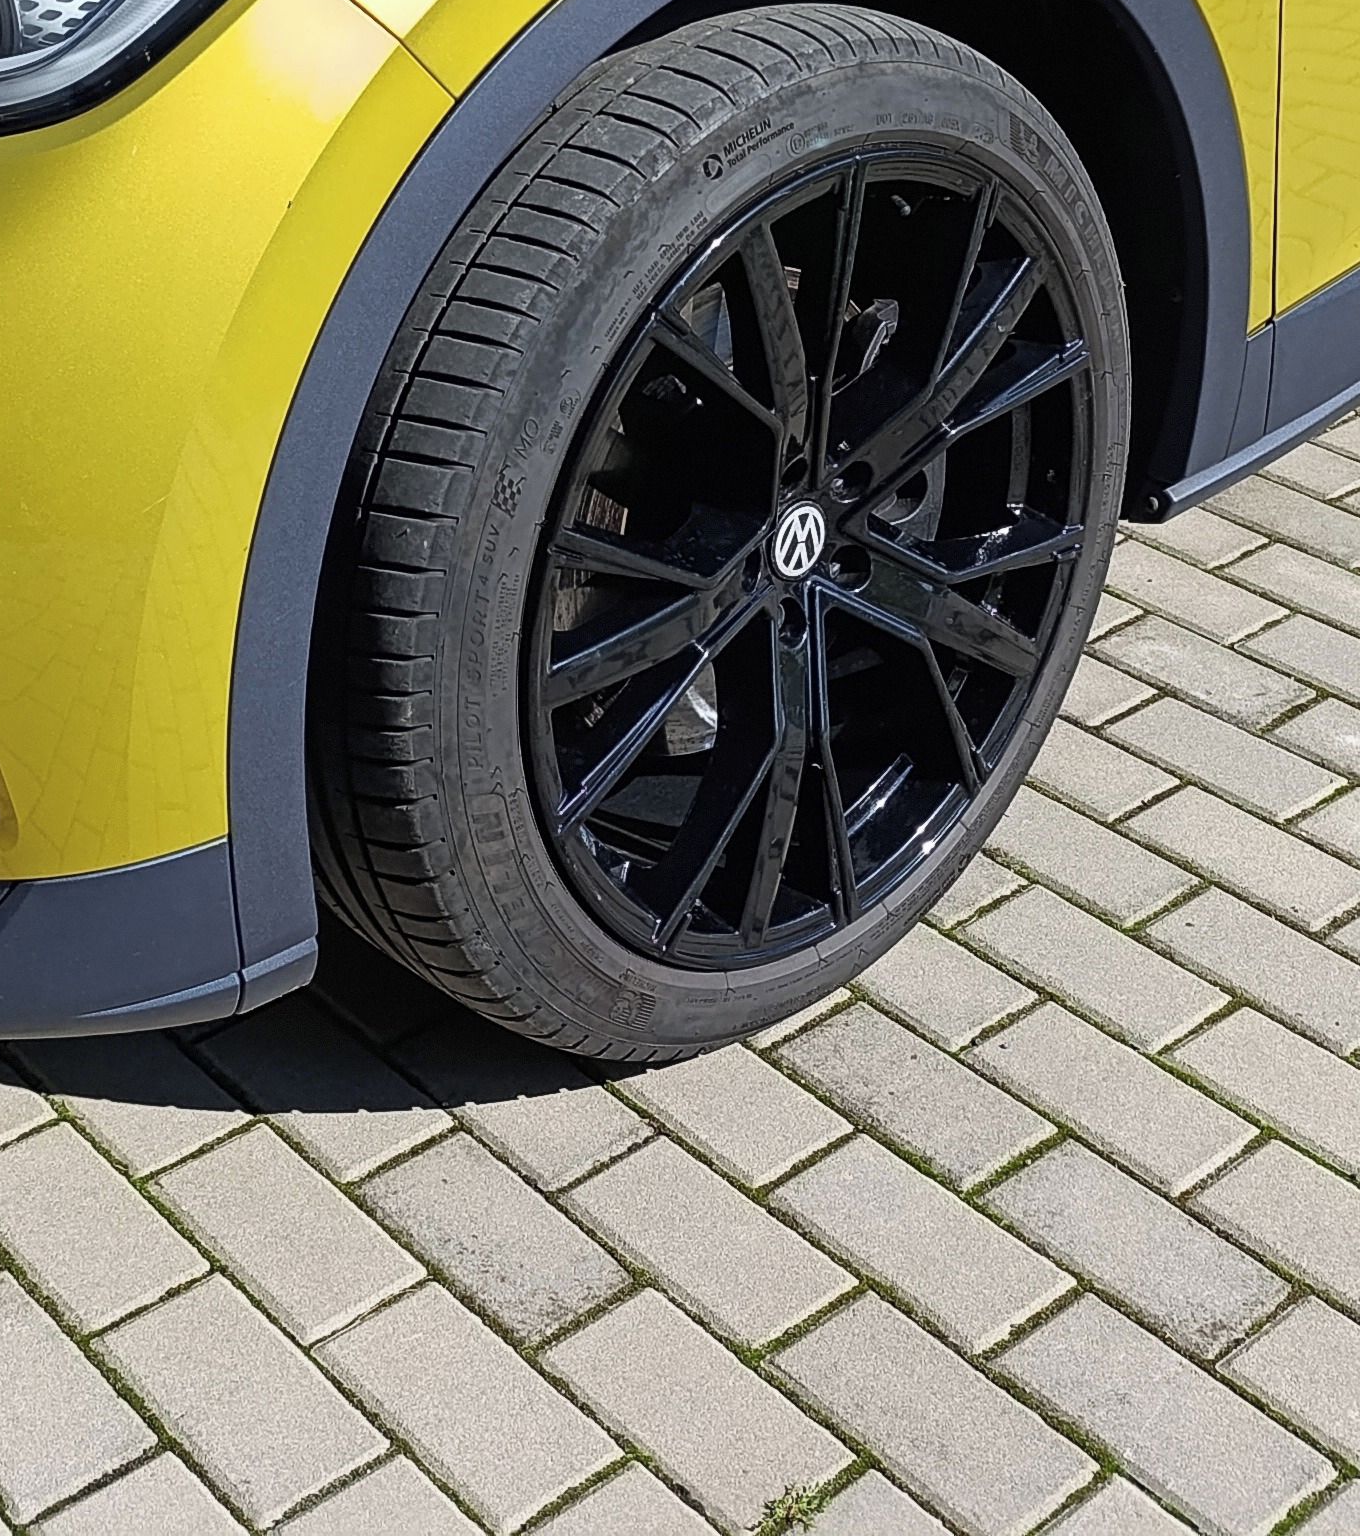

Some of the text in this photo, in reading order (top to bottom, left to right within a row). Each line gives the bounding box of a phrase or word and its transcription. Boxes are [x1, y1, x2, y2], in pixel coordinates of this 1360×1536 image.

[723, 118, 771, 157] MICHELIN
[726, 150, 746, 168] Total
[747, 122, 795, 156] Performance
[514, 418, 539, 460] MO
[464, 524, 501, 770] PILOT SPORT 4 SUV
